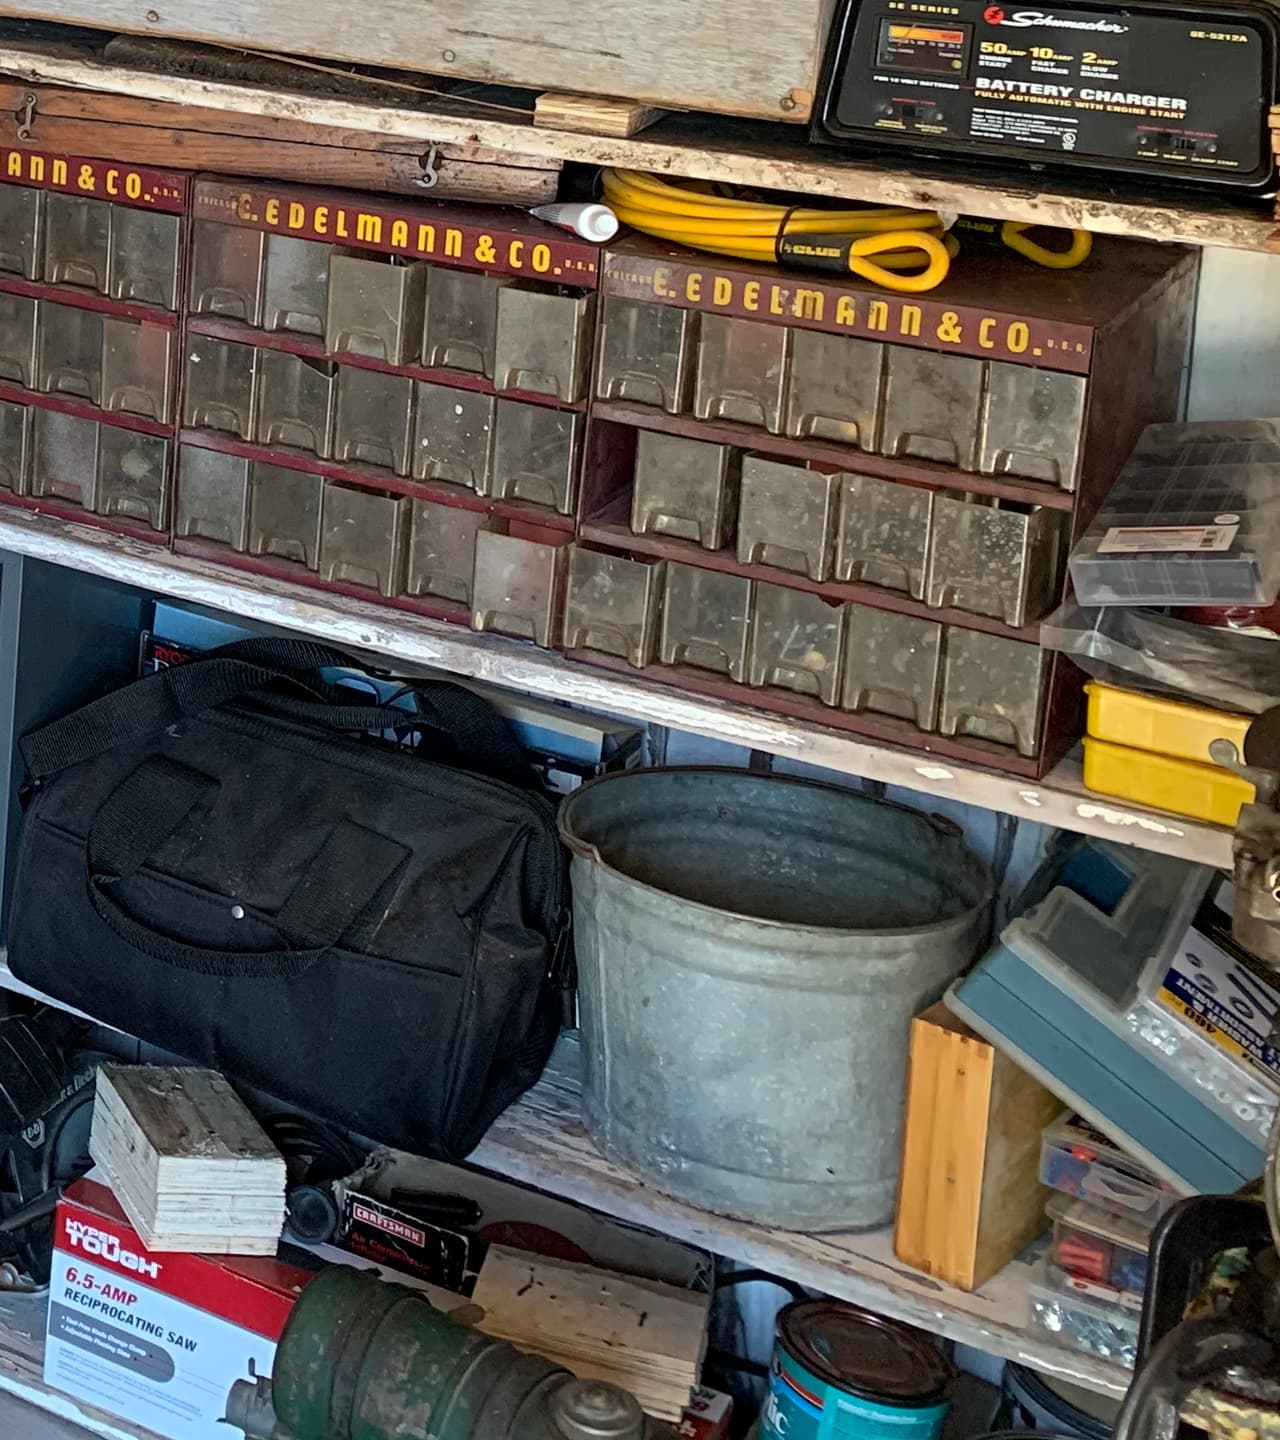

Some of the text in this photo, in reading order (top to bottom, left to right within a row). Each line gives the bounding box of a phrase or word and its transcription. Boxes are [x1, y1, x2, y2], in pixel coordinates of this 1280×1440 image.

[911, 4, 959, 15] SERIES
[1002, 11, 1129, 34] Schumacher
[978, 60, 1008, 69] START
[974, 91, 1186, 120] FULLY AUTOMATIC WITH ENGINE START
[975, 78, 1188, 110] BATTERY CHARGER
[78, 164, 95, 191] &
[106, 170, 154, 202] CO.
[265, 198, 463, 258] EDELMANN
[474, 234, 496, 264] &
[509, 239, 562, 275] CO.
[652, 266, 677, 297] E.
[686, 273, 922, 338] EDELMANN
[936, 311, 963, 343] &
[978, 317, 1042, 356] CO.
[1176, 977, 1265, 1048] ASSORTMENT
[1205, 1009, 1263, 1059] WASHER
[73, 1066, 97, 1090] Deck
[65, 1218, 120, 1247] HYPER
[356, 1208, 420, 1243] CRAFTSMAN
[67, 1229, 162, 1279] TOUGH
[65, 1267, 137, 1306] 6.5-AMP
[64, 1287, 198, 1353] RECIPROCATING SAW
